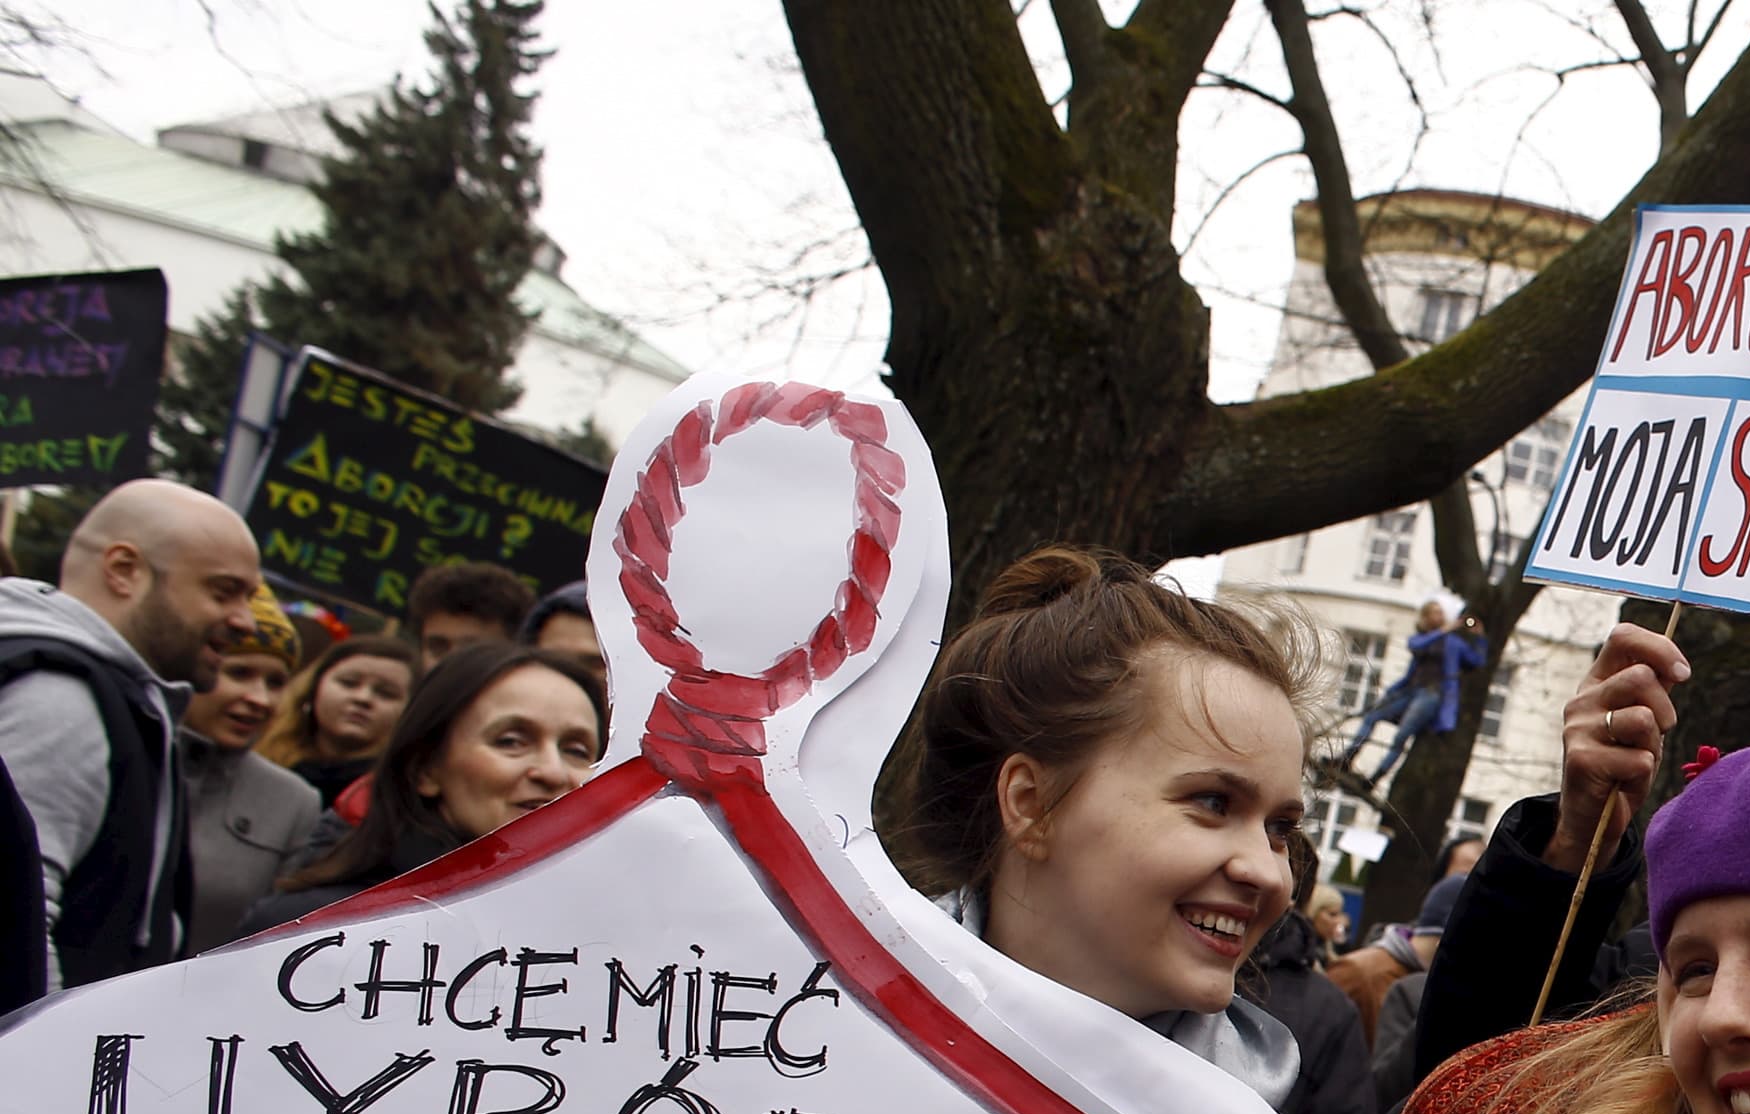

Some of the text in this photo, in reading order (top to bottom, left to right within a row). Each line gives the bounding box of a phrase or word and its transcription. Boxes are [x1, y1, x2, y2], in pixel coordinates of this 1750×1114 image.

[265, 480, 398, 560] TO JEJ
[1544, 416, 1707, 575] MOJA
[264, 528, 347, 584] NIE
[277, 931, 840, 1079] CHCĘ MIEĆ
